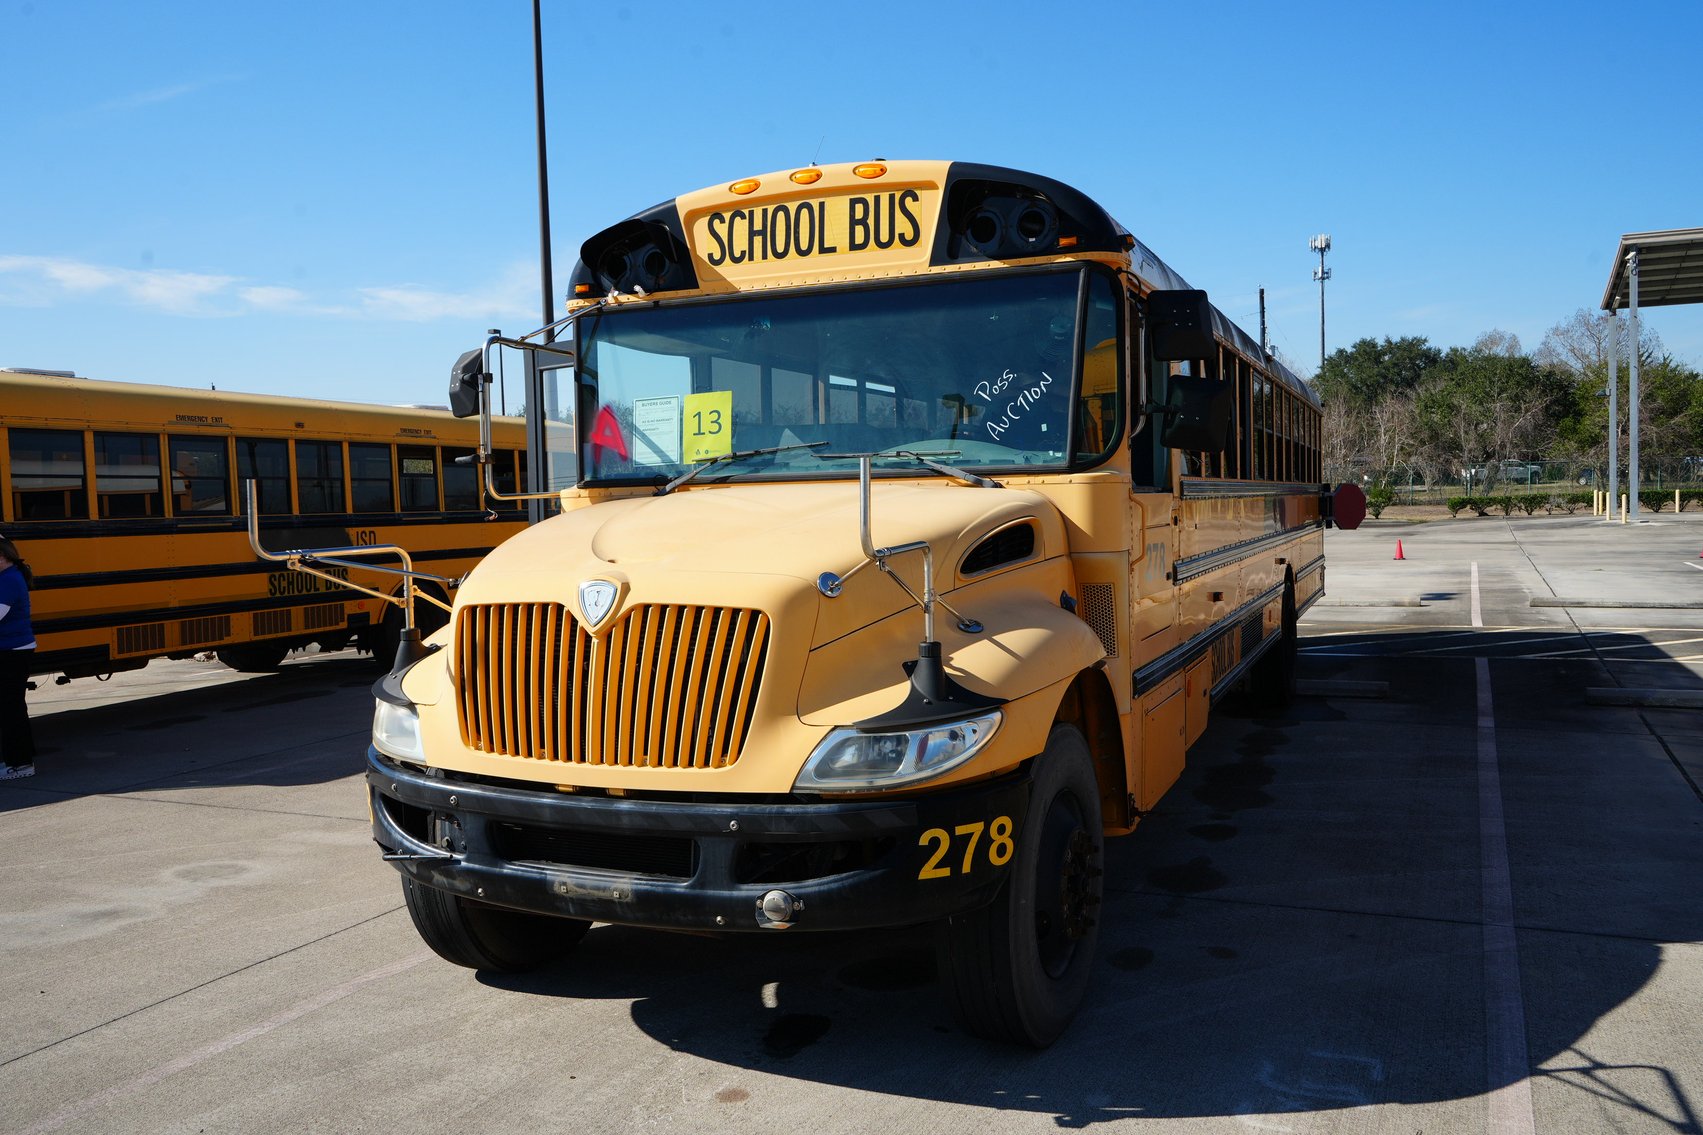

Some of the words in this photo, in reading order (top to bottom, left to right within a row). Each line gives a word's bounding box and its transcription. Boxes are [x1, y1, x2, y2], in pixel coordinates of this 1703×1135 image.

[707, 201, 837, 267] SCHOOL
[848, 189, 921, 252] BUS
[175, 414, 208, 423] EMERGENCY
[211, 416, 223, 424] EXIT
[692, 409, 723, 436] 13
[268, 571, 320, 597] SCHOOL
[325, 568, 349, 591] BUS
[918, 815, 1014, 880] 278
